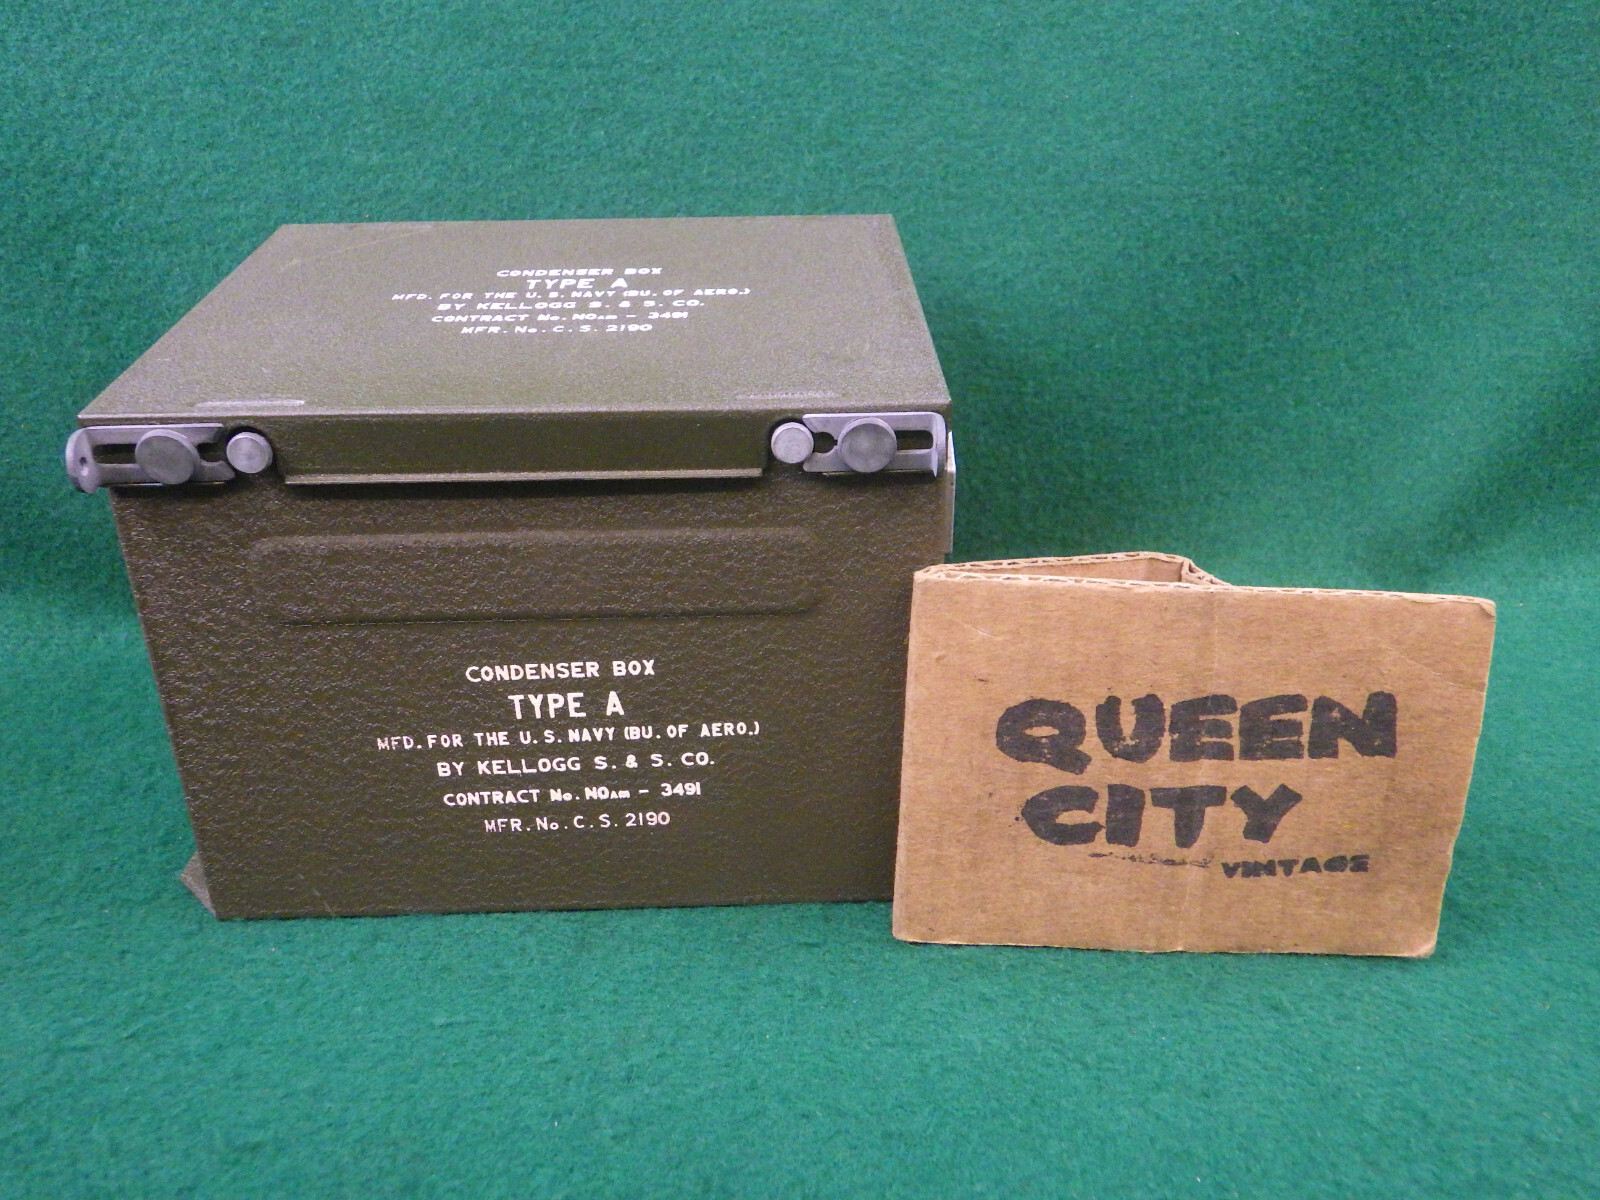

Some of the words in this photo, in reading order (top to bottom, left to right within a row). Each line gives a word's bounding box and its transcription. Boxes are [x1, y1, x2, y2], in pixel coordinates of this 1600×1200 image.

[496, 268, 614, 277] CONDENSER
[624, 267, 663, 275] BOX
[526, 278, 596, 290] TYPE
[610, 277, 628, 288] A
[437, 303, 467, 311] BY
[476, 301, 577, 310] KELLOGG
[672, 299, 705, 307] CO.
[439, 292, 474, 300] FOR
[484, 291, 518, 299] THE
[571, 290, 616, 298] NAVY
[693, 288, 751, 296] AERO.)
[431, 314, 530, 323] CONTRACT
[647, 311, 689, 320] 3491
[460, 326, 508, 334] MFR.
[605, 323, 653, 332] 2190
[465, 661, 600, 682] CONDENSER
[612, 659, 655, 677] BOX
[508, 692, 587, 719] TYPE
[606, 690, 624, 716] A
[377, 736, 422, 750] MFD.
[427, 733, 464, 749] FOR
[474, 731, 510, 746] THE
[568, 726, 615, 742] NAVY
[624, 725, 661, 740] (BU.
[666, 724, 689, 738] OF
[700, 721, 760, 738] AERO.)
[996, 691, 1398, 775] QUEEN
[437, 761, 465, 777] BY
[477, 756, 581, 775] KELLOGG
[625, 754, 638, 769] &
[681, 751, 715, 766] CO.
[443, 789, 540, 806] CONTRACT
[660, 781, 702, 797] 3491
[484, 818, 531, 833] MFR.
[625, 811, 671, 828] 2190
[1021, 783, 1303, 848] CITY
[1220, 854, 1370, 879] VINTAGE
